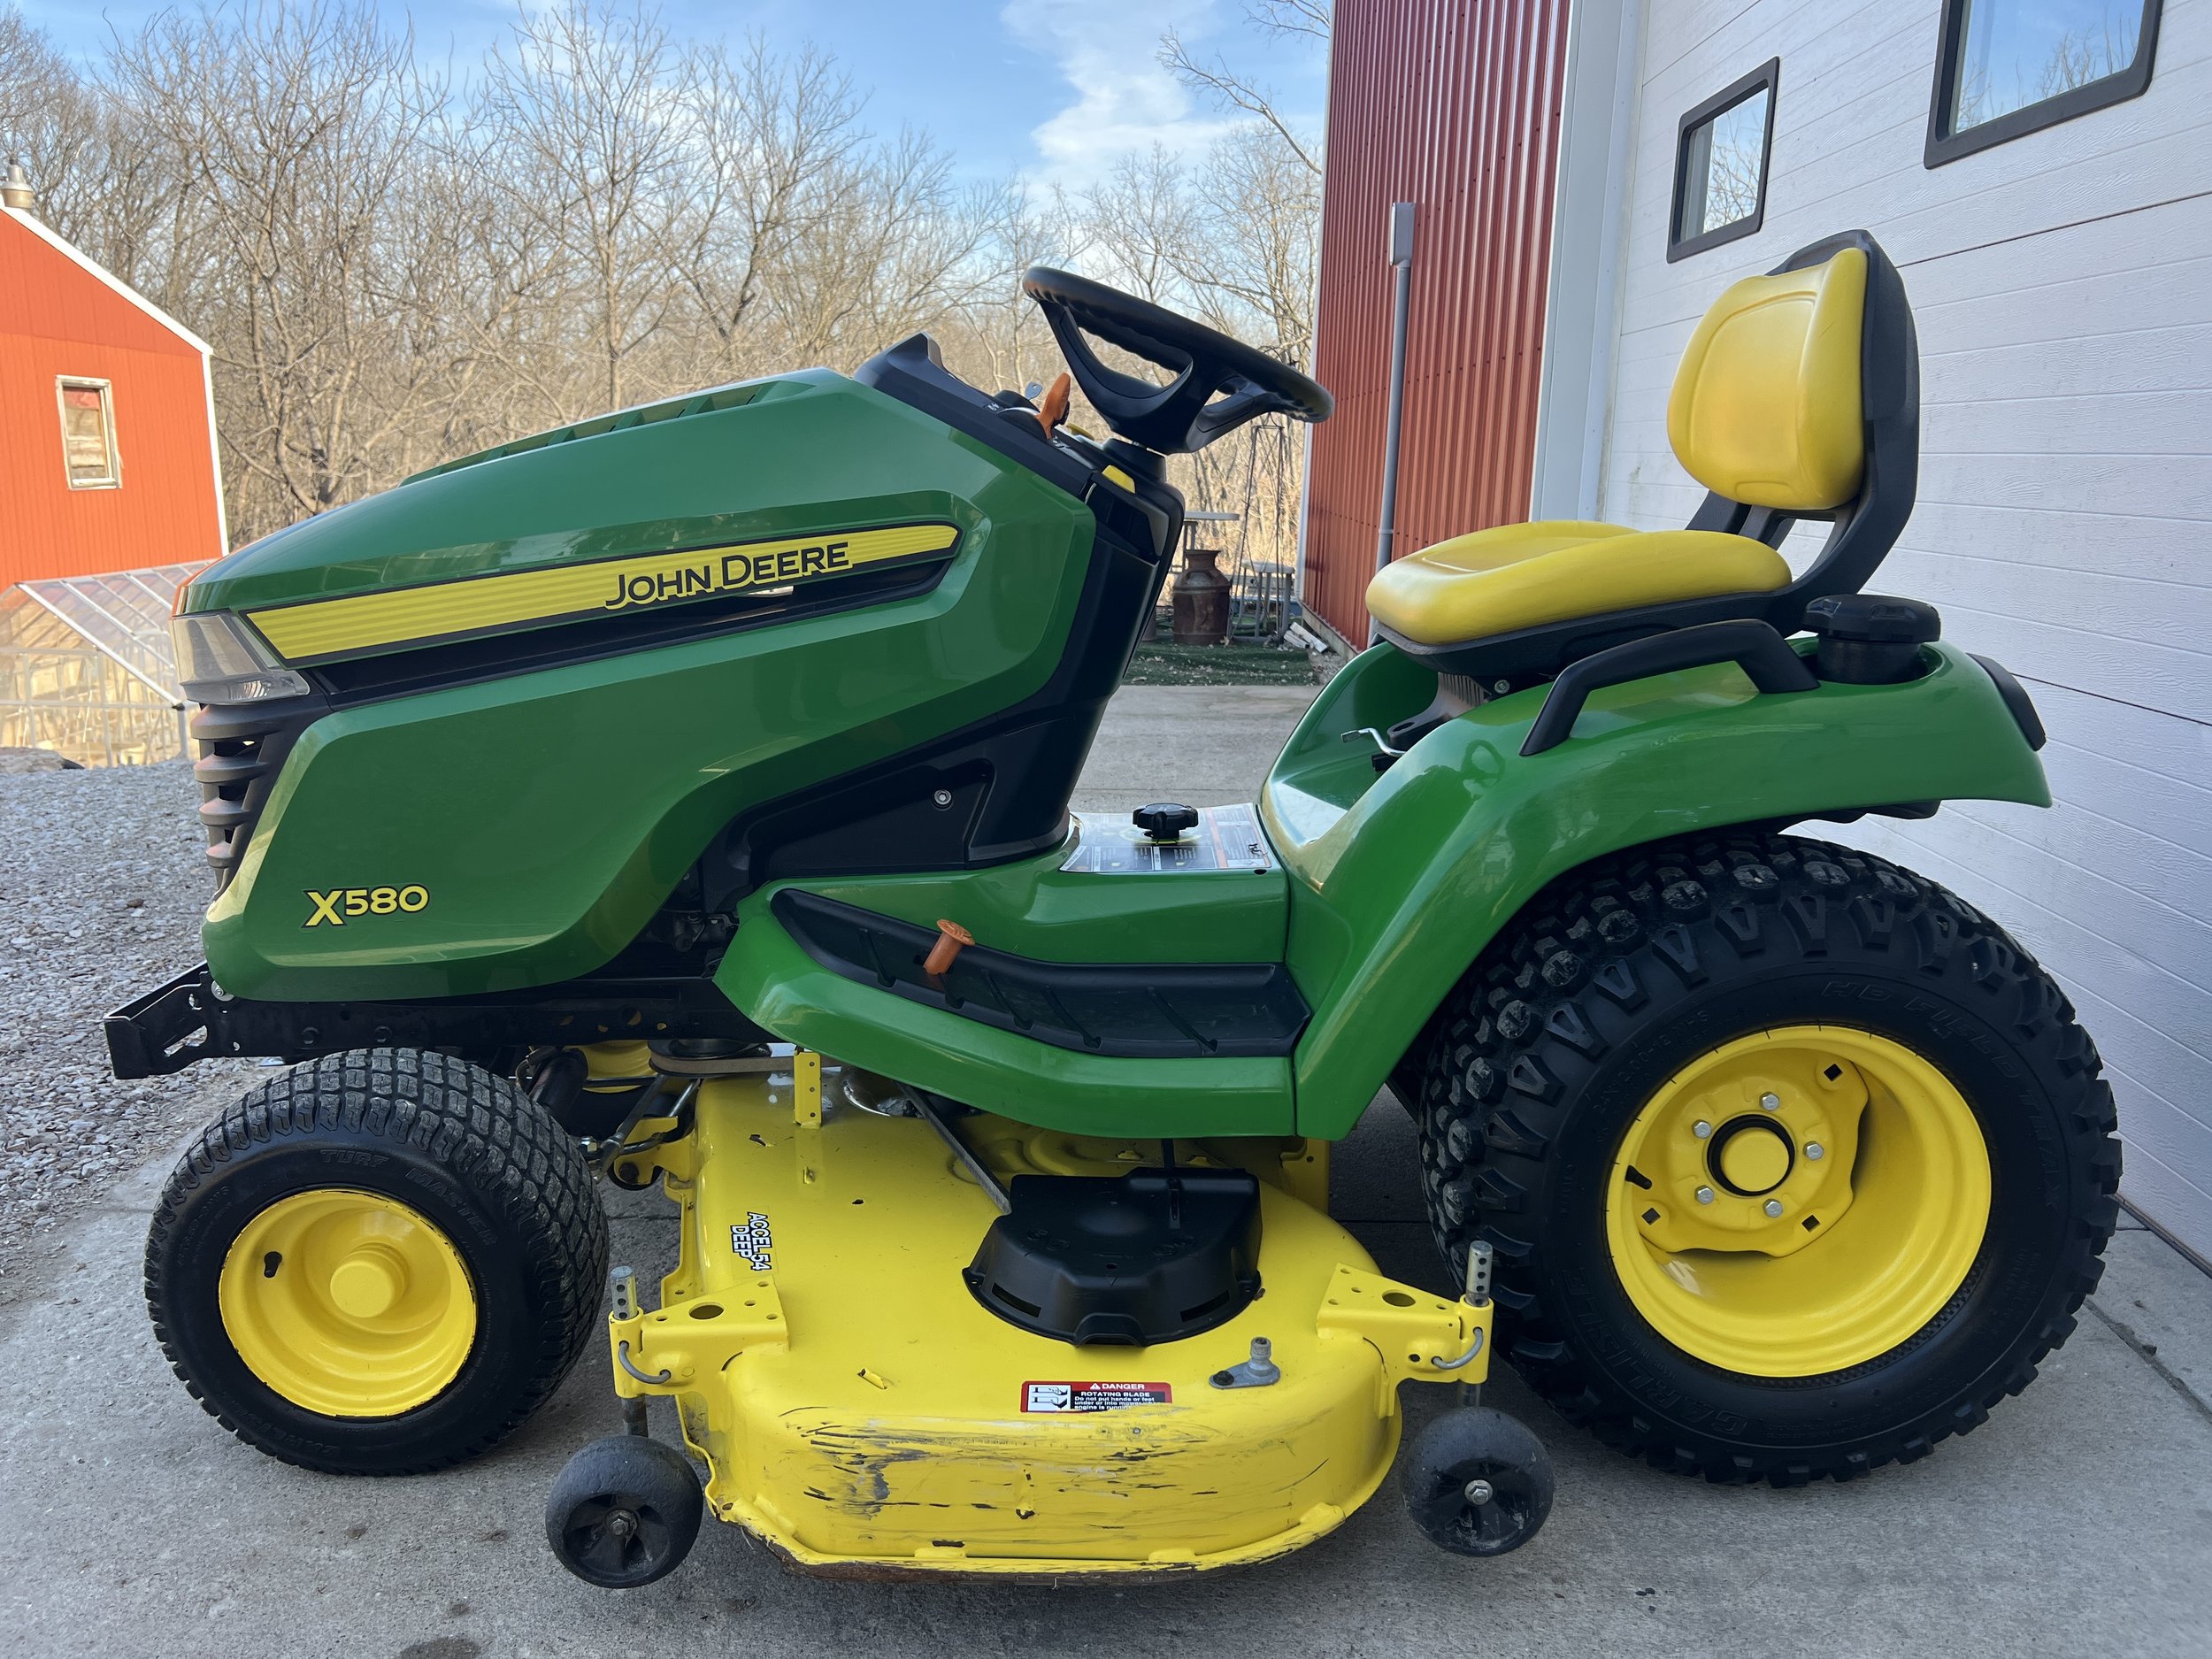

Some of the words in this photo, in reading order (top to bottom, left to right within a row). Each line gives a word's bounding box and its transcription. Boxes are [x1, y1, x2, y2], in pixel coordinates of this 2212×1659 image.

[605, 565, 712, 607] JOHN
[720, 541, 850, 587] DEERE
[302, 884, 430, 928] X580
[320, 1149, 389, 1169] TURF
[730, 1225, 753, 1258] DEEP
[747, 1211, 772, 1253] ACCEL
[750, 1254, 772, 1271] 54
[1562, 1267, 1748, 1435] CARLISLE
